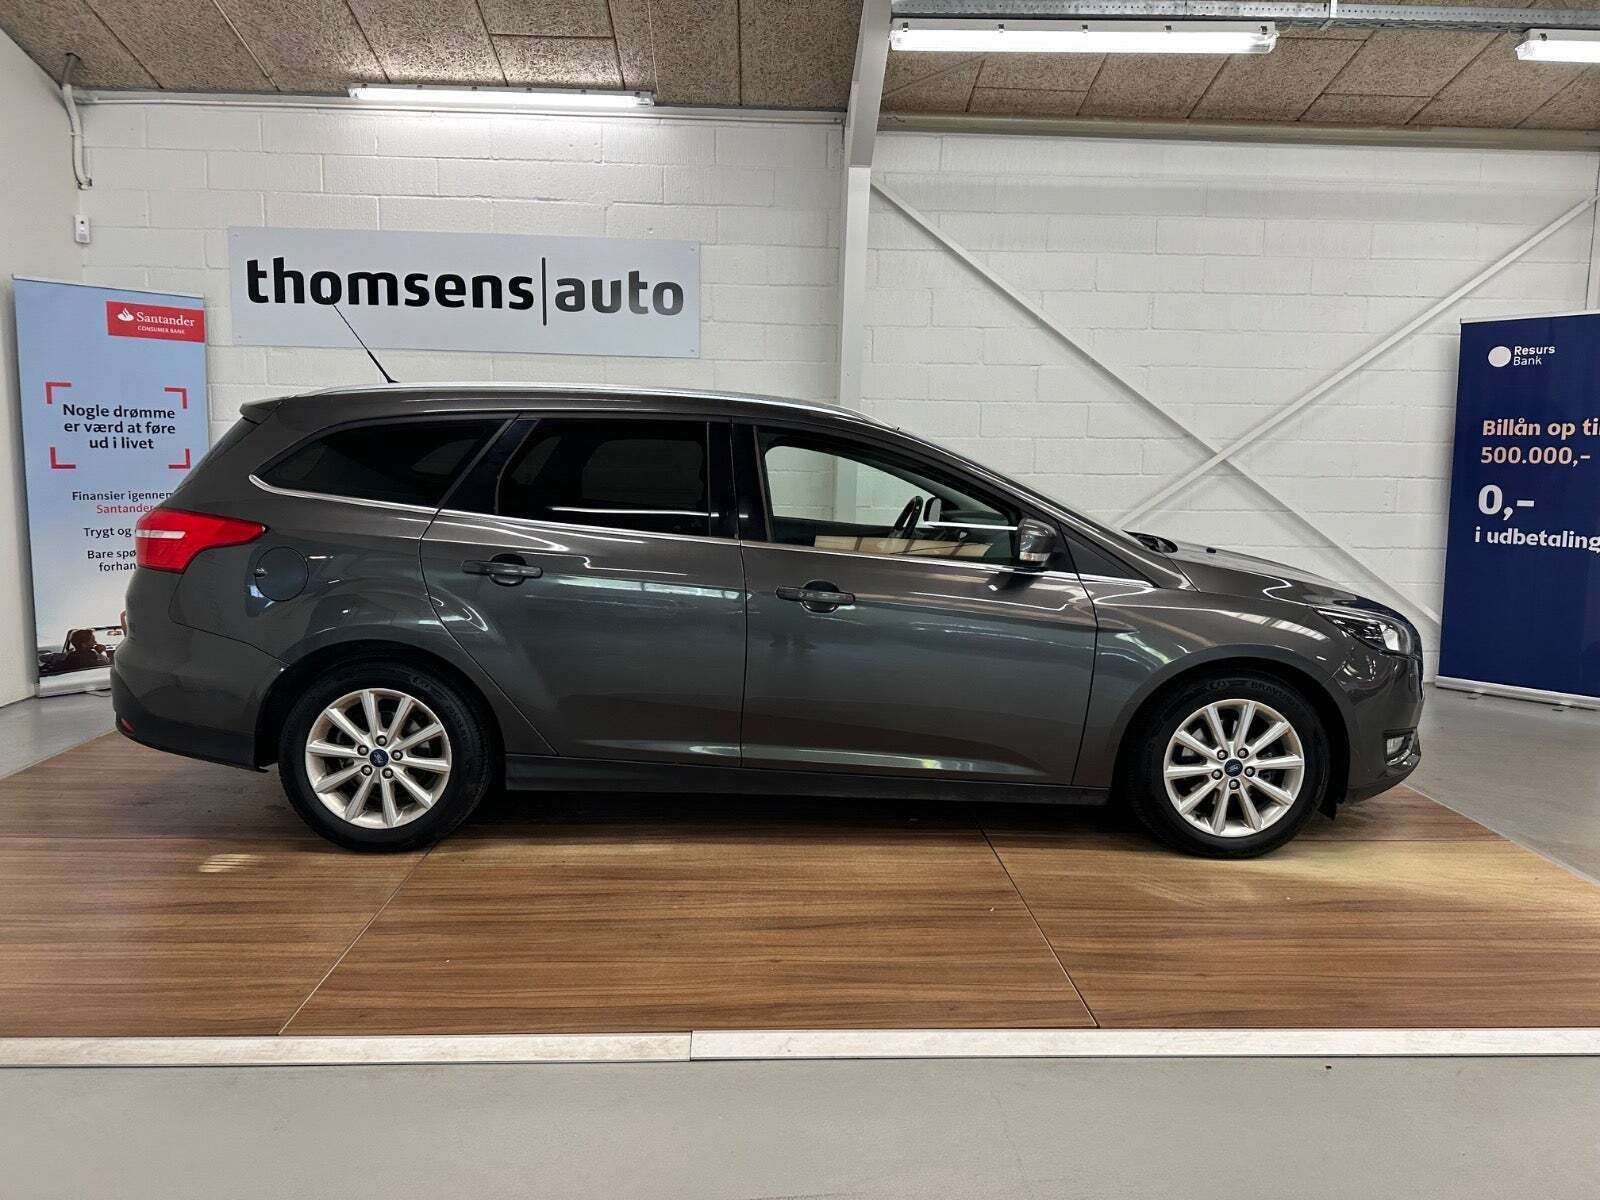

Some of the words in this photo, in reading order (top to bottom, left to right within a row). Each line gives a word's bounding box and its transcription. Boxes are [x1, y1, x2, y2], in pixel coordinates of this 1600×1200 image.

[246, 257, 534, 310] thomsens
[555, 270, 684, 316] auto
[136, 311, 195, 327] Santander
[1514, 345, 1556, 356] Resurs
[1513, 355, 1542, 366] Bank
[63, 404, 109, 420] Nogle
[113, 405, 176, 419] drømme
[64, 423, 80, 432] er
[84, 421, 124, 433] værd
[128, 423, 142, 434] at
[145, 421, 176, 435] føre
[1482, 417, 1541, 436] Billån
[1547, 422, 1576, 440] op
[1582, 417, 1600, 436] ti
[89, 436, 109, 449] ud
[113, 436, 117, 449] i
[121, 436, 155, 449] livet
[1480, 446, 1591, 467] 500.000,-
[72, 491, 126, 501] Finansier
[1478, 484, 1535, 521] 0,-
[83, 527, 115, 538] Trygt
[117, 528, 132, 538] og
[1474, 526, 1481, 543] i
[1486, 527, 1600, 553] udbetaling
[87, 550, 114, 559] Bare
